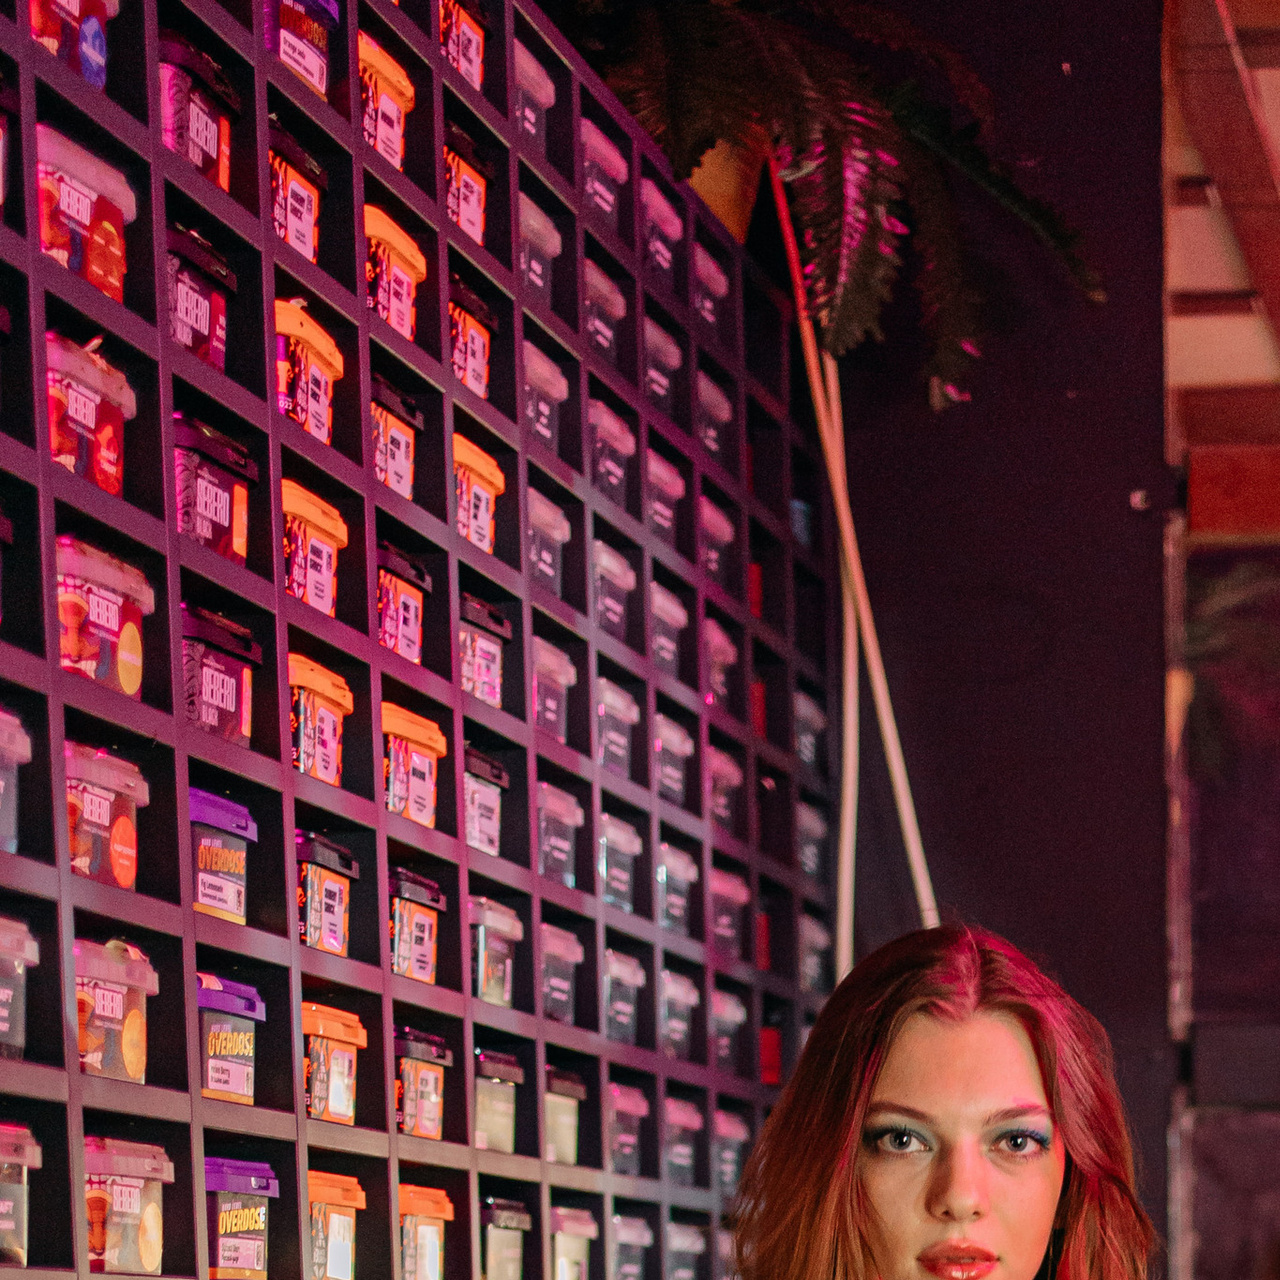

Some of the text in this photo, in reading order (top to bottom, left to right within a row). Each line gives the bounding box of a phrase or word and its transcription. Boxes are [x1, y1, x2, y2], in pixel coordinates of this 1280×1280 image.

[189, 101, 218, 160] SEBERO
[59, 181, 91, 226] SEBERO
[177, 281, 210, 336] SEBERO
[68, 388, 96, 430] SEBERO
[197, 476, 230, 527] SEBERO
[89, 593, 119, 633] SEBERO
[202, 664, 237, 713] SEBERO
[83, 792, 111, 828] SEBERO
[198, 844, 247, 875] OVERDOSE
[95, 987, 124, 1020] SEBERO
[208, 1031, 254, 1057] OVERDOSE
[113, 1185, 141, 1214] SEBERO
[218, 1206, 266, 1235] OVERDOSE
